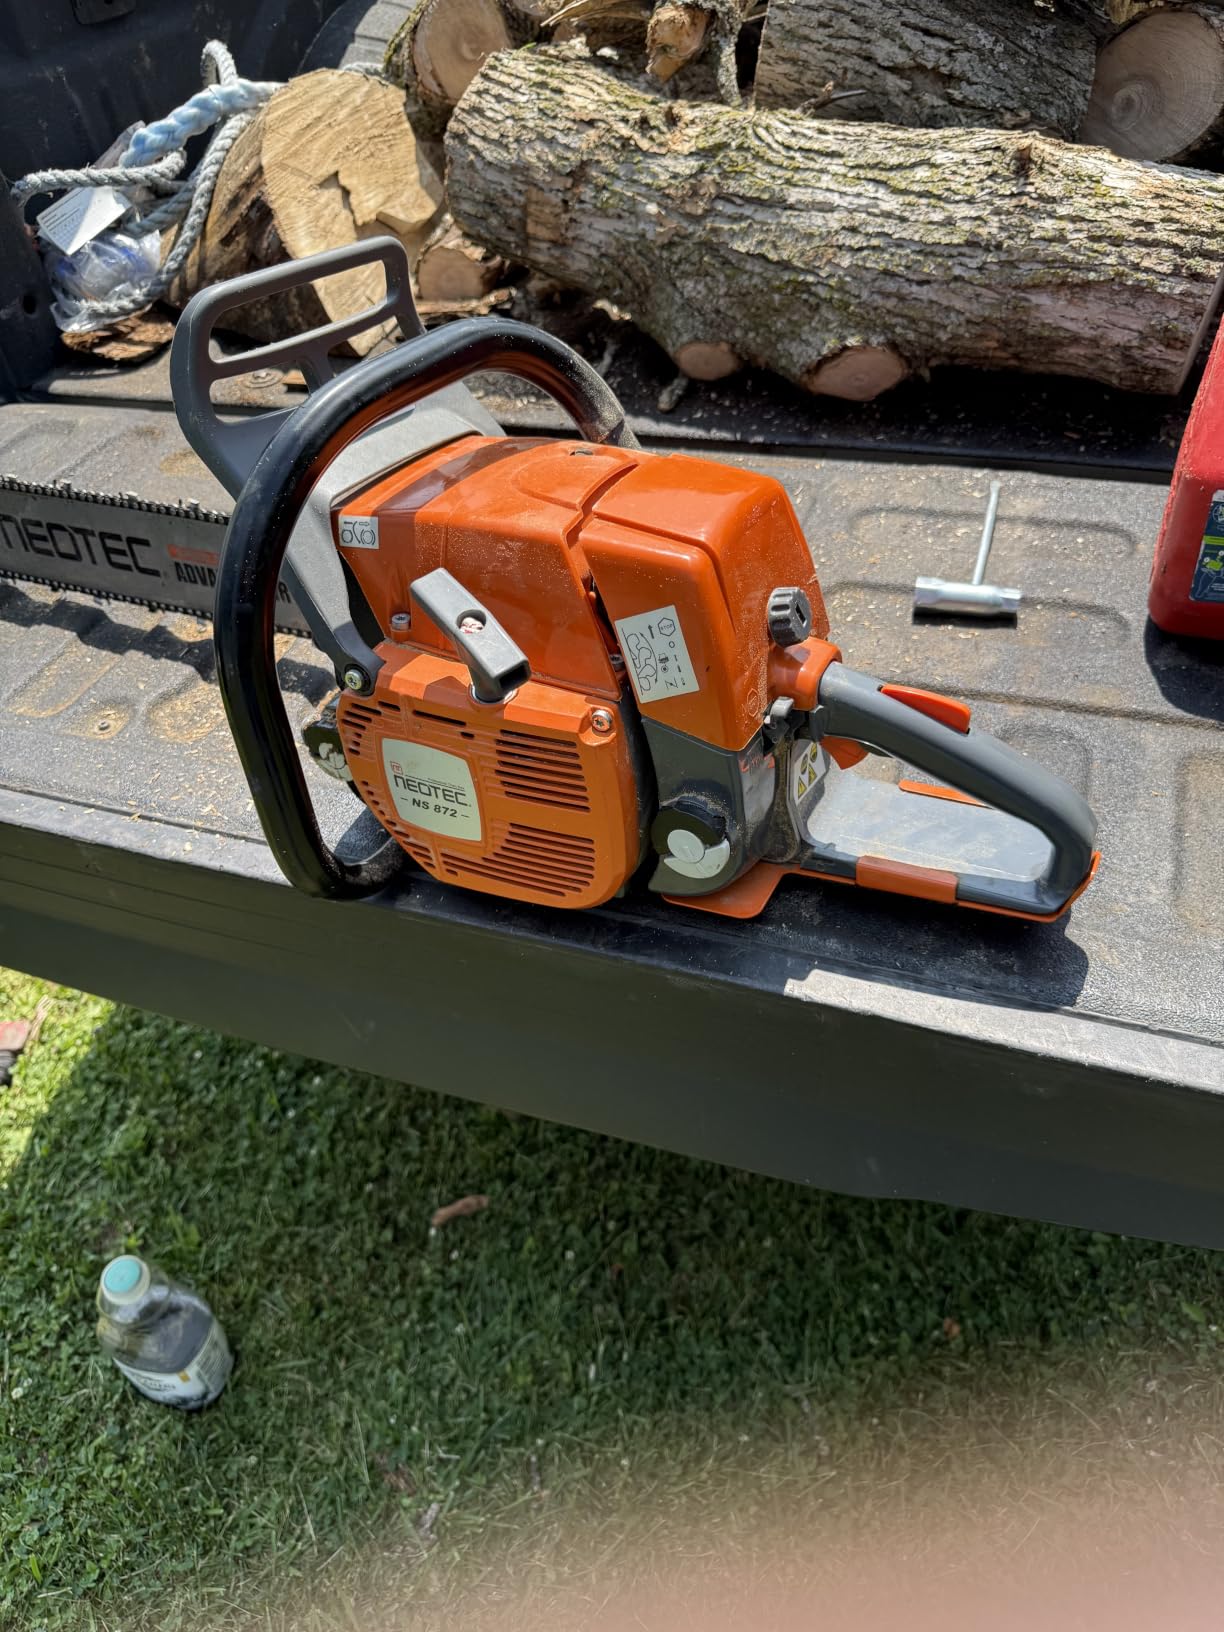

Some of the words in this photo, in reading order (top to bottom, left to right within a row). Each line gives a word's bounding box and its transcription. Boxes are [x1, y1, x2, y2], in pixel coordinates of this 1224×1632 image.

[0, 513, 161, 577] NEOTEC
[174, 561, 217, 587] ADVA
[394, 774, 468, 806] NEOTEC
[412, 798, 430, 810] NS
[433, 804, 458, 818] 872
